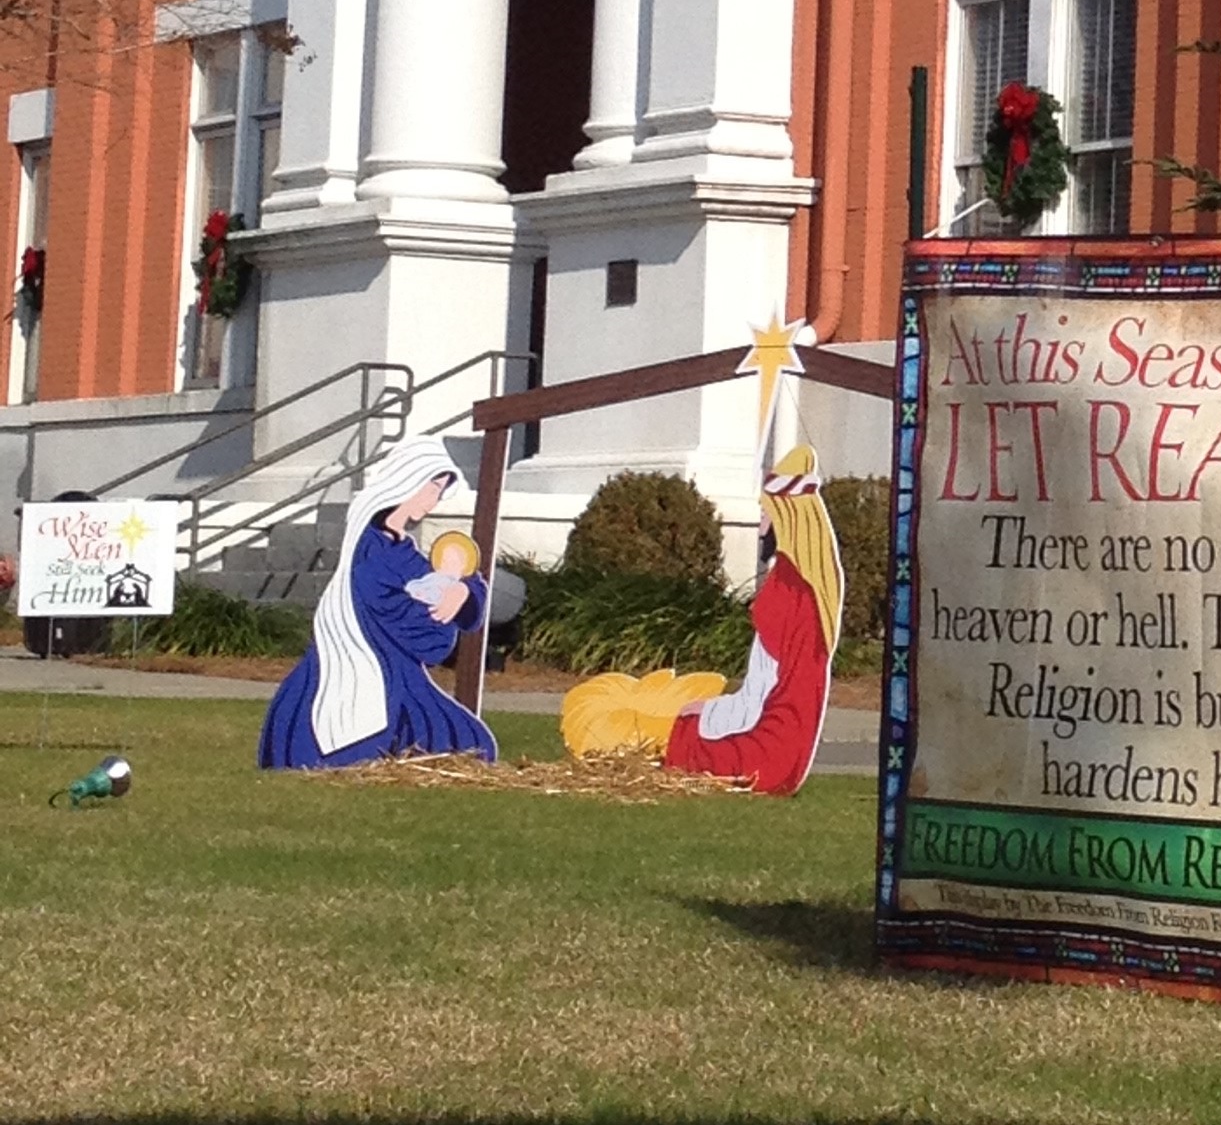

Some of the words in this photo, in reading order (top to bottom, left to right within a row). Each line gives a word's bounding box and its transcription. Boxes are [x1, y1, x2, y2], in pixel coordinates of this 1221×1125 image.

[942, 317, 983, 386] At
[994, 313, 1085, 385] this
[937, 401, 1058, 502] LET
[38, 510, 107, 538] Wise
[57, 534, 121, 562] Men
[982, 515, 1090, 571] There
[1100, 533, 1152, 573] are
[1164, 535, 1215, 574] no
[31, 572, 104, 609] Him
[931, 589, 1054, 645] heaven
[1066, 614, 1109, 647] or
[1116, 593, 1189, 650] hell.
[987, 662, 1146, 738] Religion
[1154, 671, 1182, 727] is
[1041, 741, 1198, 806] hardens
[909, 812, 1056, 873] FREEDOM
[1068, 827, 1170, 886] FROM
[1055, 896, 1115, 919] Freedom
[1117, 901, 1149, 925] From
[1151, 906, 1210, 933] Religion
